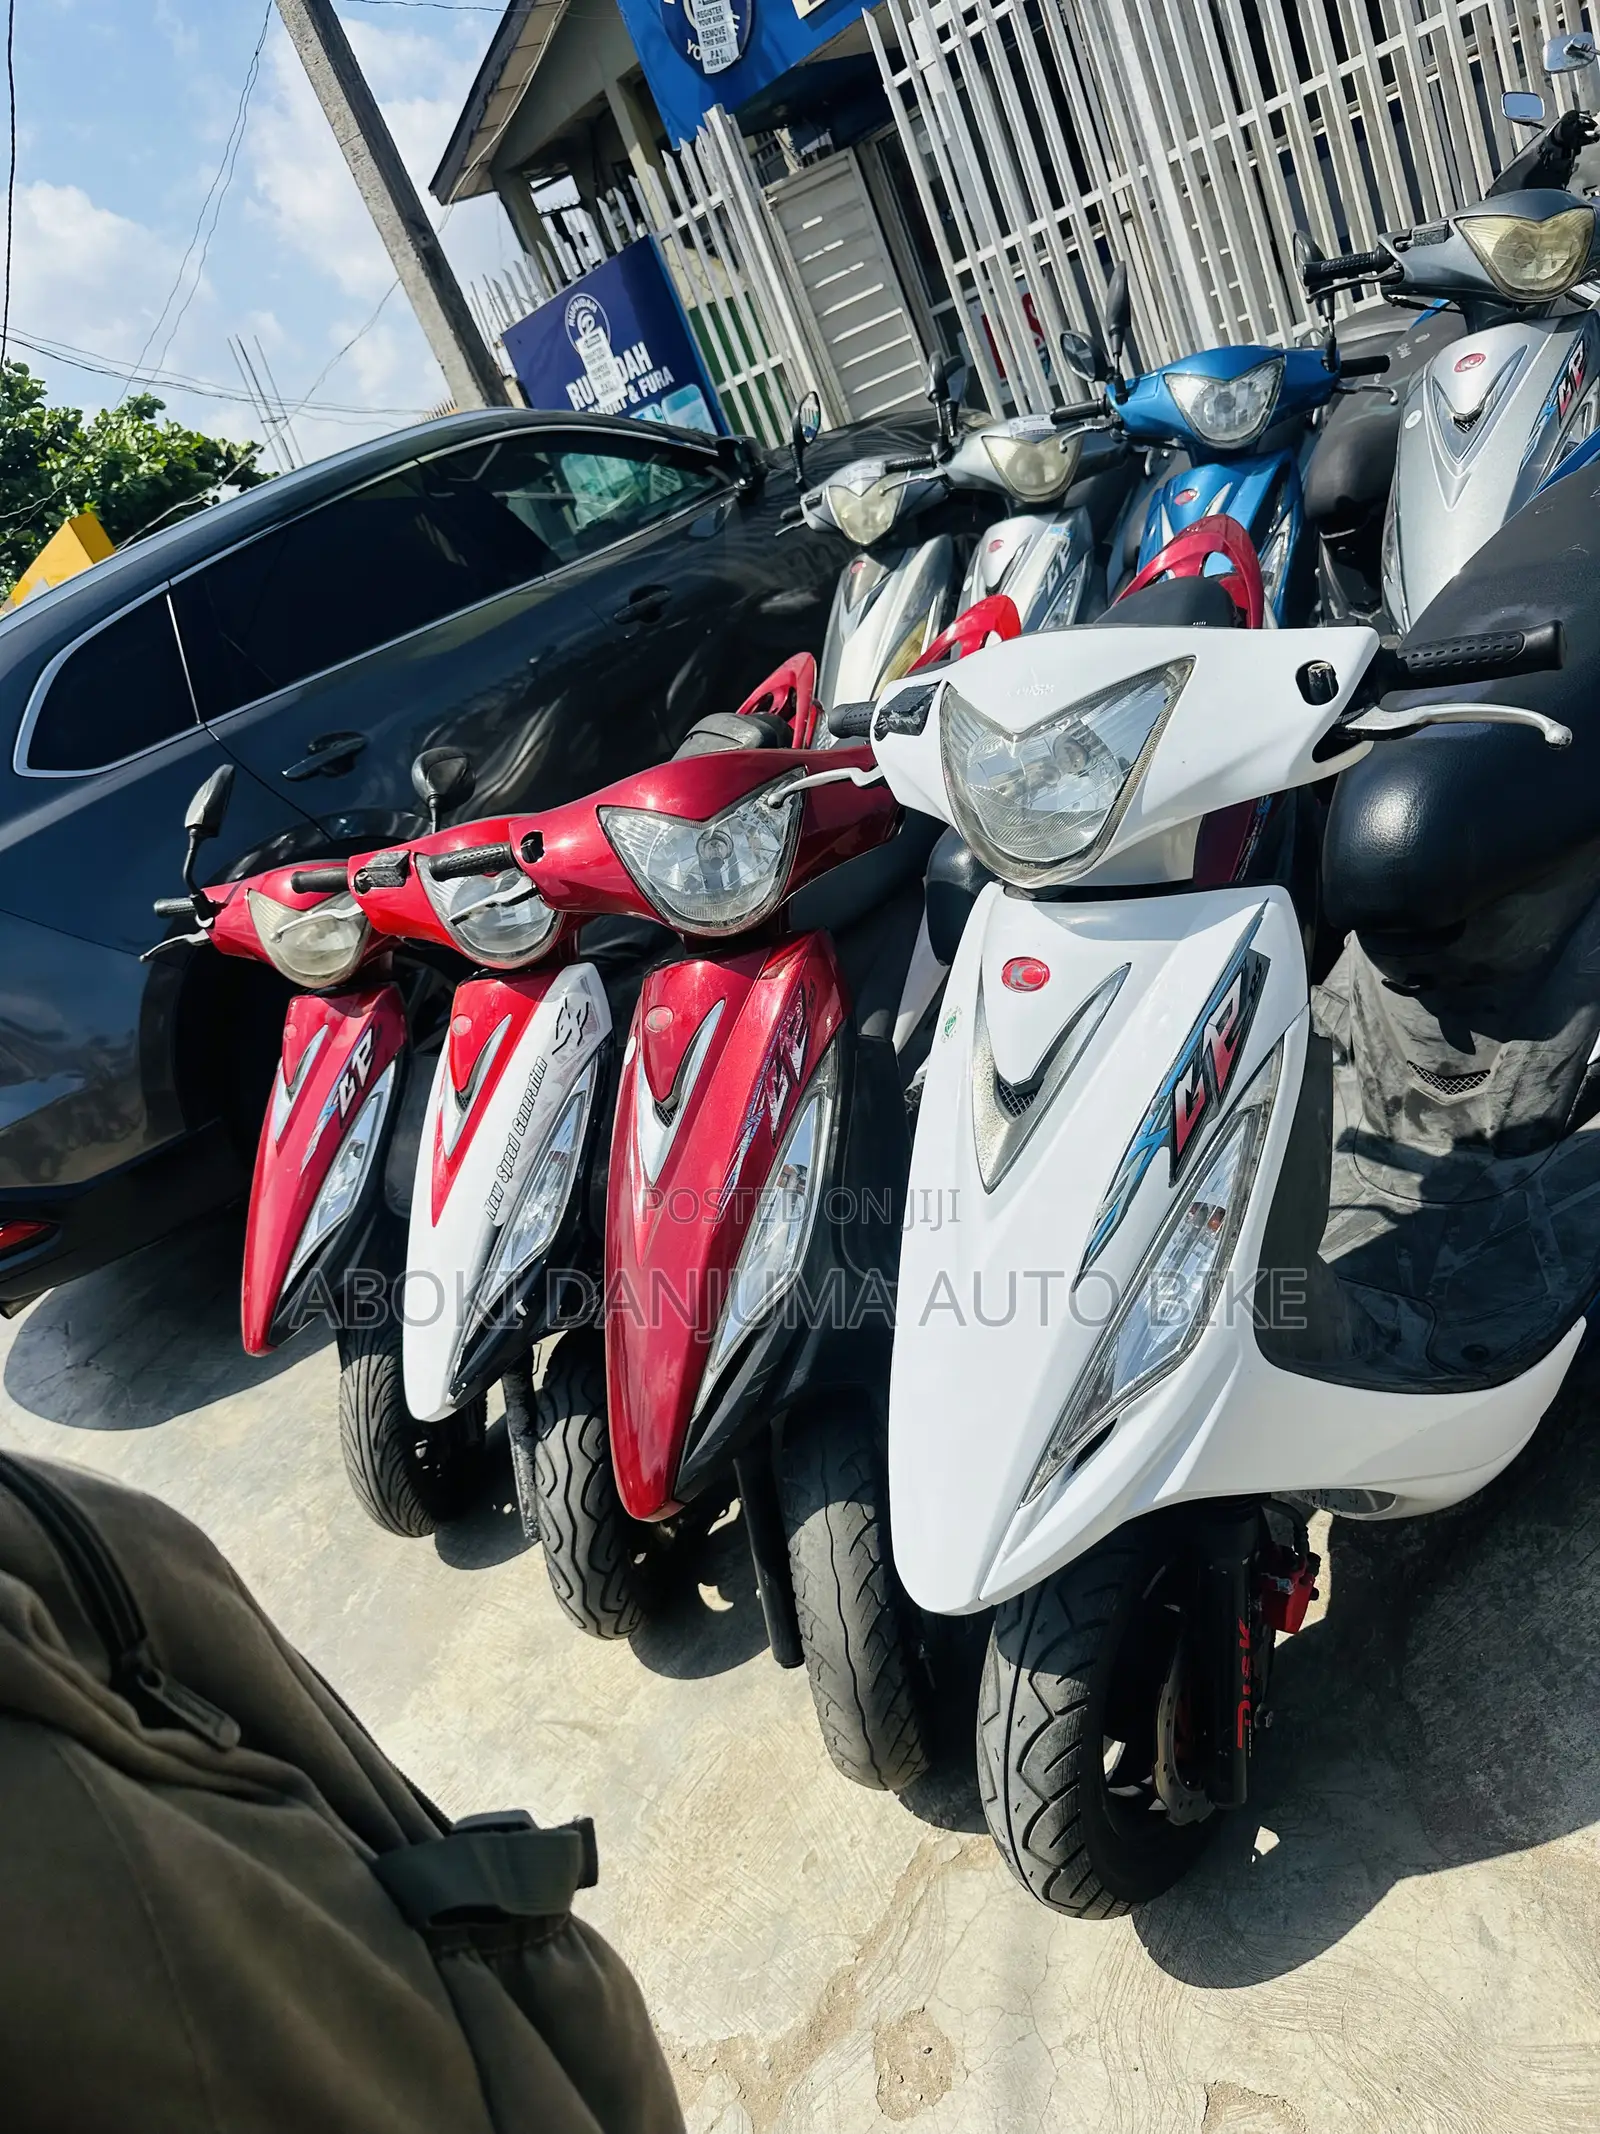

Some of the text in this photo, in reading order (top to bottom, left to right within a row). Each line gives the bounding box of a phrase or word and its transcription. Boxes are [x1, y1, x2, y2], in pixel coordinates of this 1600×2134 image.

[696, 5, 722, 19] REGISTER
[698, 14, 724, 27] YOUR SIGN
[701, 25, 726, 39] REMOVE
[715, 35, 727, 45] SIGN
[710, 47, 723, 59] PAY
[627, 384, 641, 404] &
[637, 365, 675, 398] FURA
[483, 1055, 548, 1221] New Speed Generation
